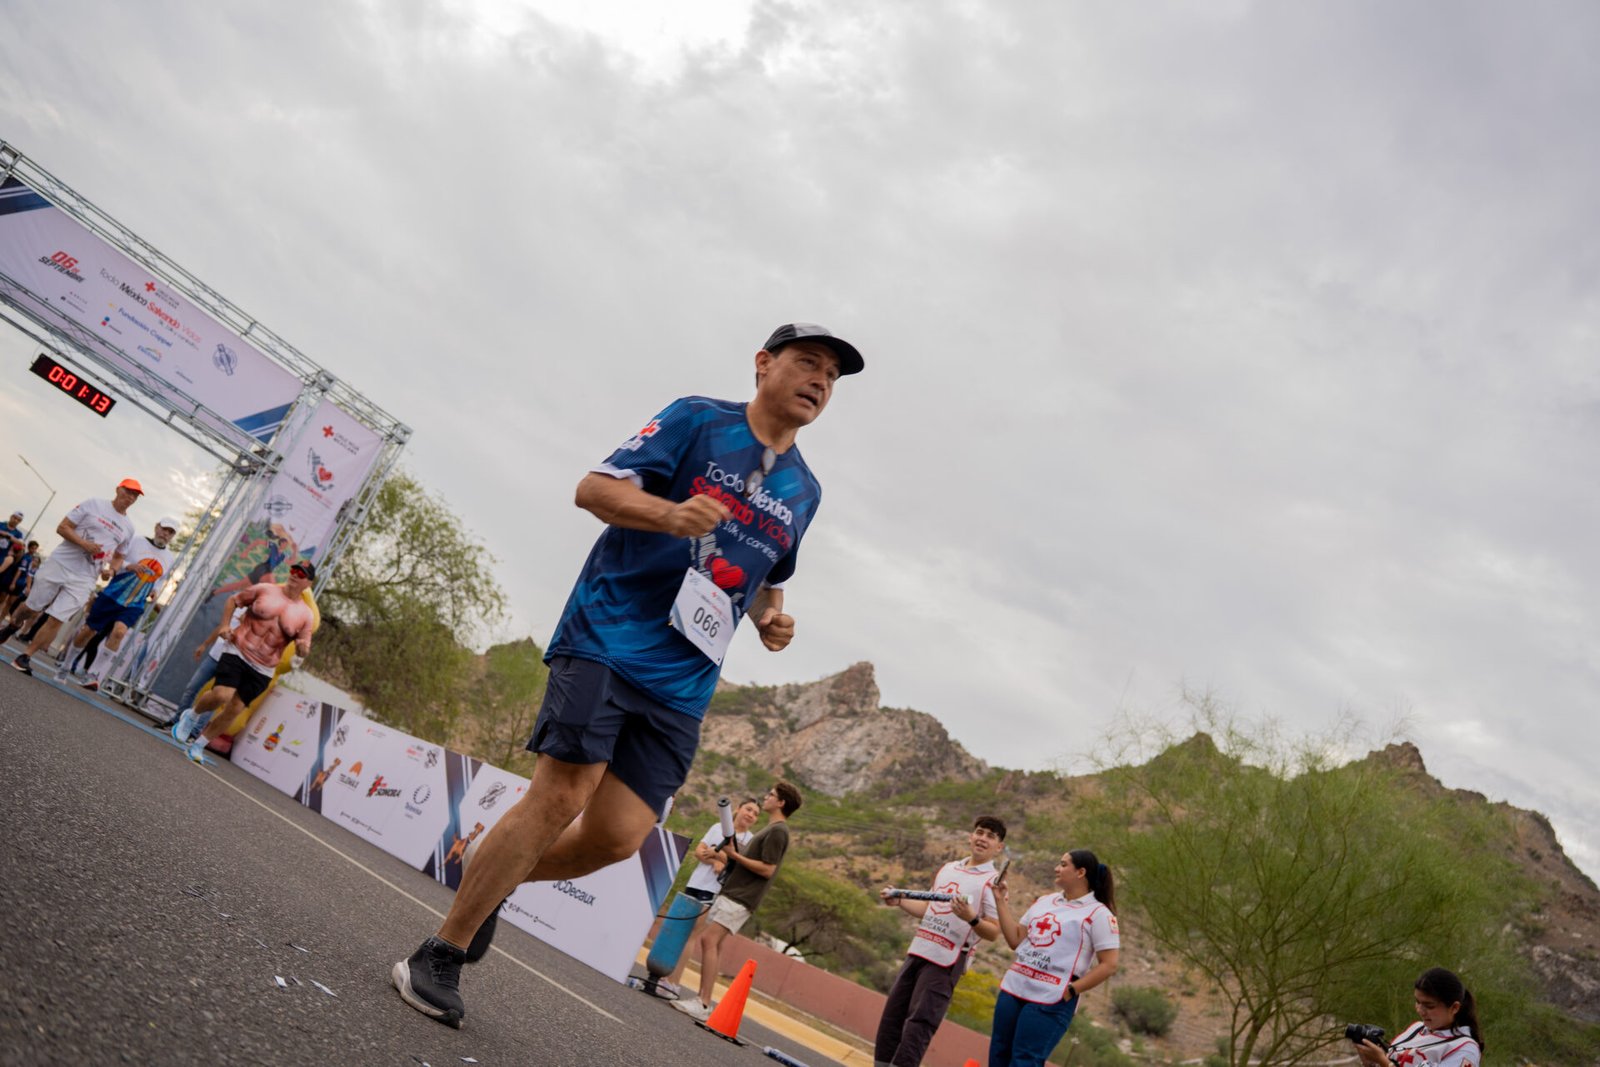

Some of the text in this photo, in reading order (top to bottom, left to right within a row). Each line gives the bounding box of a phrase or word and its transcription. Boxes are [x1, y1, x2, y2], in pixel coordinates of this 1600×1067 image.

[38, 256, 85, 283] SEPTIEMBRE
[50, 250, 78, 269] 06
[118, 282, 148, 307] México
[147, 301, 181, 329] Salvando
[705, 461, 793, 526] Todo México
[692, 606, 721, 639] 066
[552, 880, 597, 906] JCDecaux
